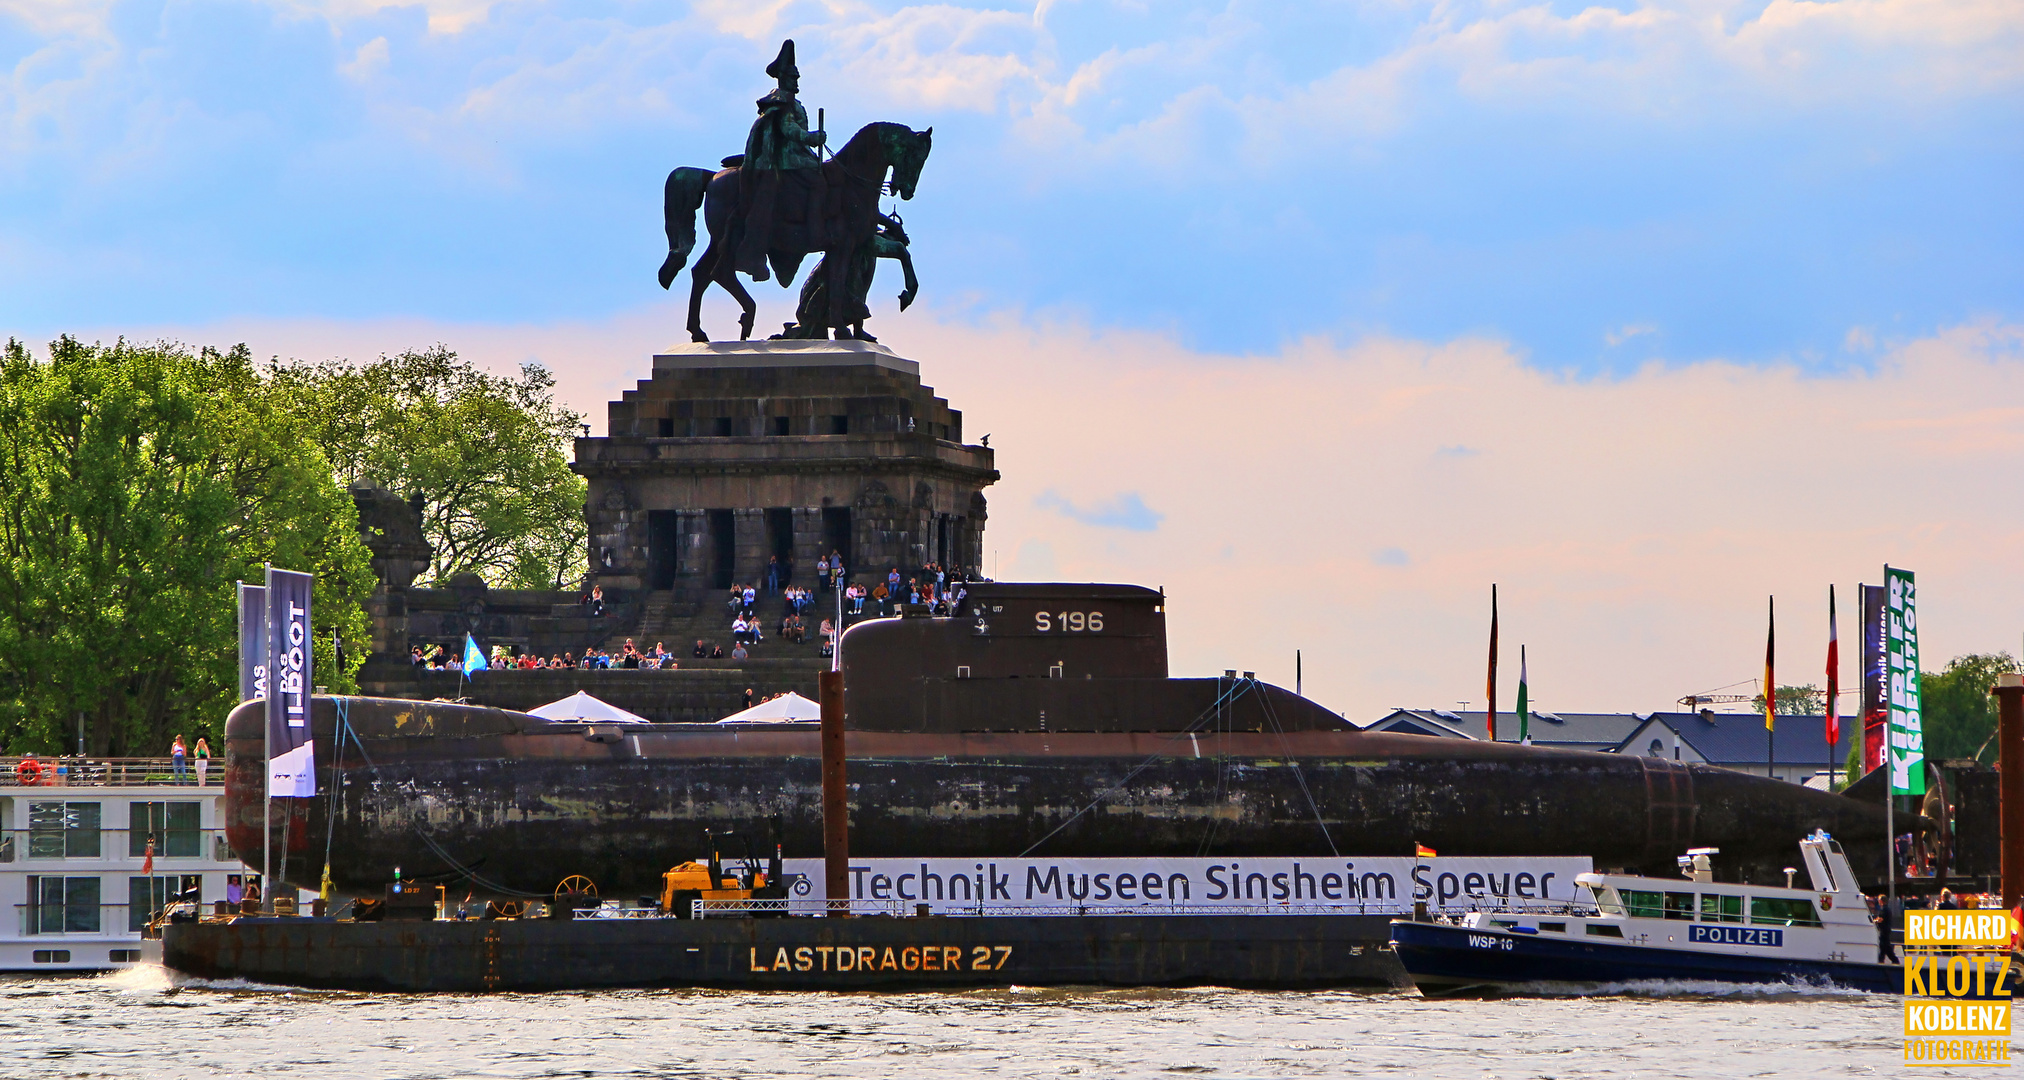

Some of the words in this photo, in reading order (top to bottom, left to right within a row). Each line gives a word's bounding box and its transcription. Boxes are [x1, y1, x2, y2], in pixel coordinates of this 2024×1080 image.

[992, 605, 1003, 613] U17
[1035, 611, 1051, 632] S
[1058, 611, 1104, 632] 196
[279, 653, 288, 693] DAS
[848, 862, 1012, 900] Technik
[1026, 865, 1191, 900] Museen
[1205, 862, 1396, 900] Sinsheim
[1410, 864, 1556, 908] Speyer
[1468, 934, 1497, 949] WSP
[1500, 937, 1513, 951] 16
[1695, 927, 1776, 945] POLIZEI
[750, 946, 962, 972] LASTDRAGER
[971, 946, 1013, 971] 27
